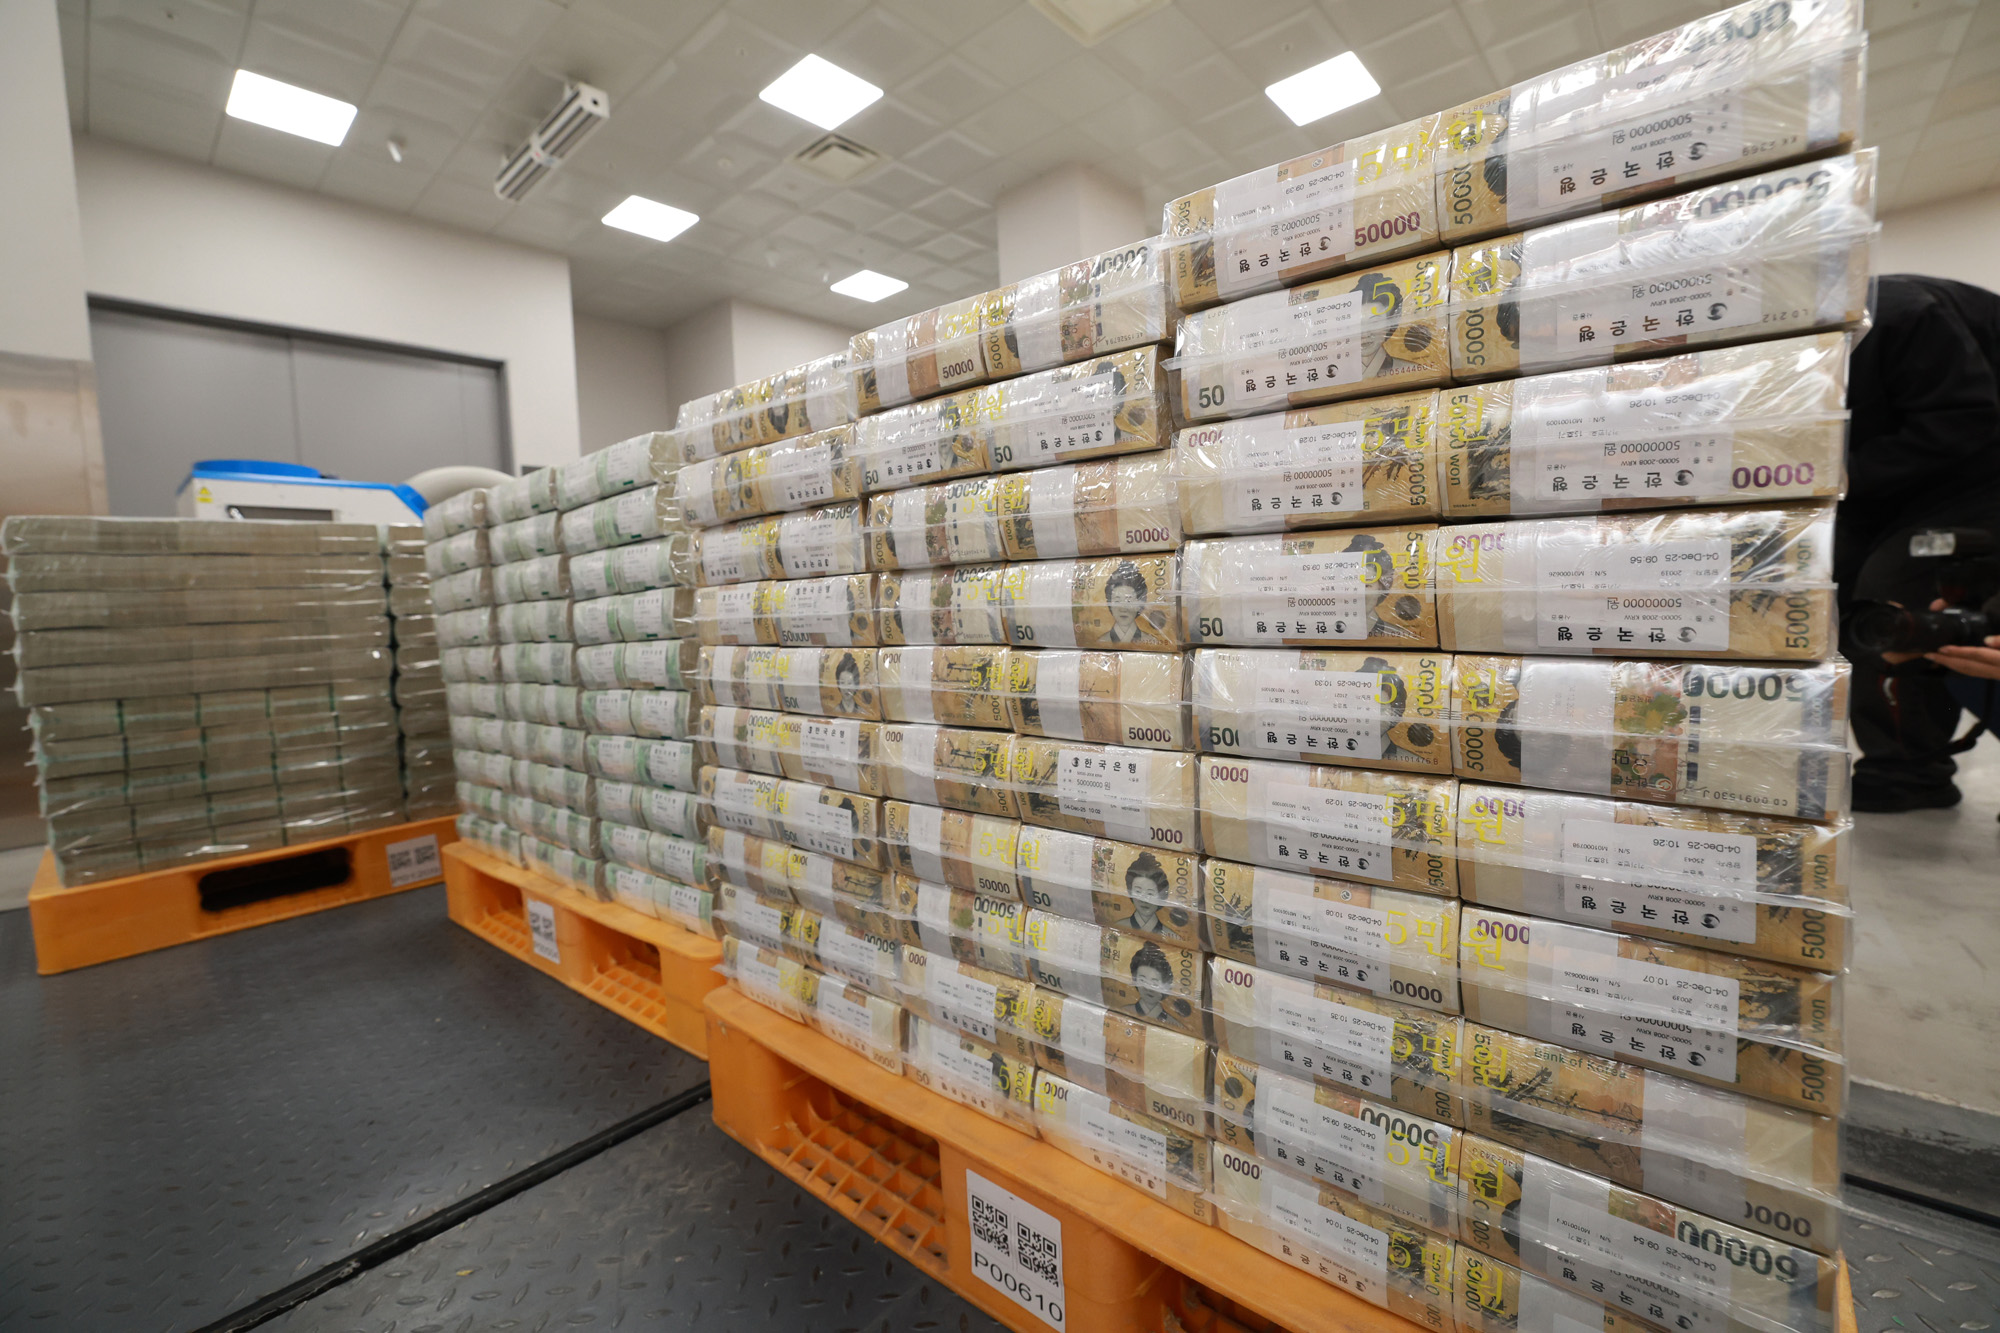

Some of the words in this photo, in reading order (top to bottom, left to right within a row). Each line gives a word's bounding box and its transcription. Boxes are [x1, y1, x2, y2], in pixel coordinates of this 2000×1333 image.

[1629, 112, 1693, 139] 50000000
[1308, 170, 1345, 188] 04-Dec-25
[1560, 150, 1675, 196] 한국은행
[1281, 213, 1321, 232] 50000000
[1353, 211, 1421, 247] 50000
[1239, 241, 1311, 273] 한국은행
[1649, 273, 1713, 295] 50000000
[1316, 301, 1352, 315] 04-Dec-25
[1578, 307, 1696, 344] 한국은행
[1289, 341, 1328, 357] 50000000
[942, 358, 974, 379] 50000
[1245, 367, 1320, 393] 한국은행
[1198, 384, 1225, 409] 50
[1665, 390, 1721, 405] 04-Dec-25
[1040, 431, 1091, 450] 한국은행
[1321, 431, 1357, 442] 04-Dec-25
[1620, 439, 1682, 453] 50000000
[994, 445, 1013, 464] 50
[865, 469, 879, 485] 50
[1293, 470, 1333, 481] 50000000
[1552, 472, 1664, 493] 한국은행
[1251, 493, 1324, 512] 한국은행
[1125, 526, 1170, 544] 50000
[1664, 552, 1720, 563] 04-Dec-25
[1297, 598, 1337, 607] 50000000
[1622, 597, 1683, 610] 50000000
[1016, 625, 1034, 641] 50
[1199, 617, 1225, 637] 50
[1256, 620, 1328, 634] 한국은행
[1557, 626, 1667, 644] 한국은행
[1337, 680, 1373, 689] 04-Dec-25
[1128, 727, 1171, 743] 50000
[1267, 731, 1339, 750] 한국은행
[1083, 758, 1138, 774] 한국은행
[1348, 800, 1384, 812] 04-Dec-25
[1278, 844, 1350, 868] 한국은행
[1687, 840, 1741, 855] 04-Dec-25
[1815, 854, 1830, 893] won
[979, 877, 1011, 895] 50000
[1032, 890, 1052, 908] 50
[1581, 896, 1690, 925] 한국은행
[1347, 914, 1383, 927] 04-Dec-25
[1279, 950, 1350, 978] 한국은행
[1390, 978, 1443, 1004] 0000
[1676, 978, 1729, 998] 04-Dec-25
[1810, 999, 1827, 1031] won
[1351, 1017, 1387, 1033] 04-Dec-25
[1571, 1022, 1677, 1060] 한국은행
[1283, 1050, 1354, 1080] 한국은행
[1533, 1047, 1567, 1066] Bank
[1567, 1055, 1584, 1071] of
[1586, 1059, 1629, 1080] Korea
[916, 1069, 930, 1087] 50
[1152, 1100, 1195, 1127] 50000
[1342, 1121, 1377, 1141] 04-Dec-25
[1093, 1154, 1144, 1184] 한국은행
[1277, 1147, 1346, 1185] 한국은행
[1345, 1225, 1380, 1246] 04-Dec-25
[1282, 1244, 1350, 1286] 한국은행
[1665, 1246, 1718, 1273] 04-Dec-25
[974, 1251, 1064, 1323] P00610
[1562, 1267, 1666, 1320] 한국은행
